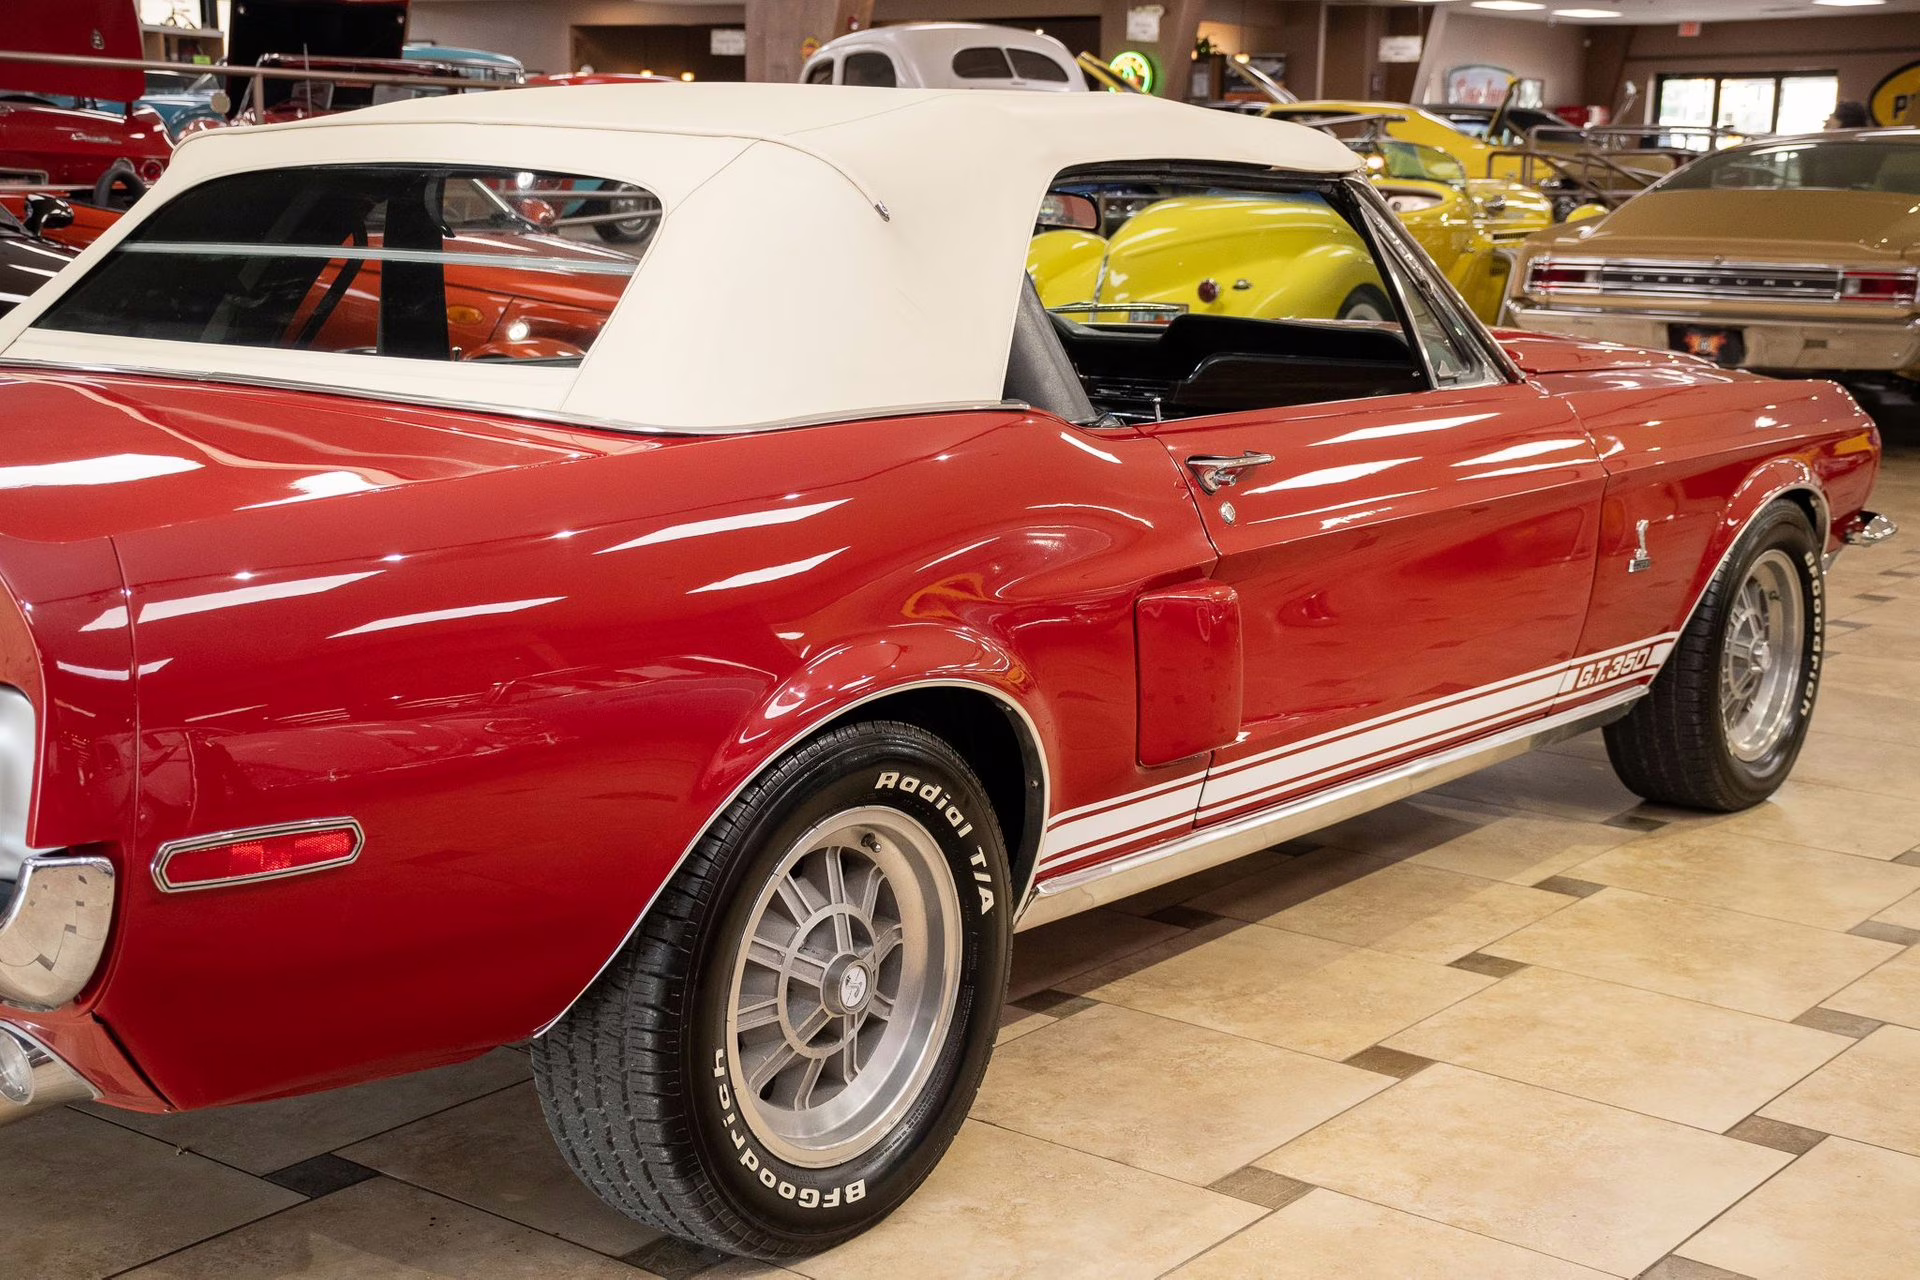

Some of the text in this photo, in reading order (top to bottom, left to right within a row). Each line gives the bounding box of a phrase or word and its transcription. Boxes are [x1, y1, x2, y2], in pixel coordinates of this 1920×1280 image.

[1631, 274, 1803, 287] MERCURY
[874, 771, 994, 915] Radial T/A
[714, 1048, 866, 1208] BFGoodrich
